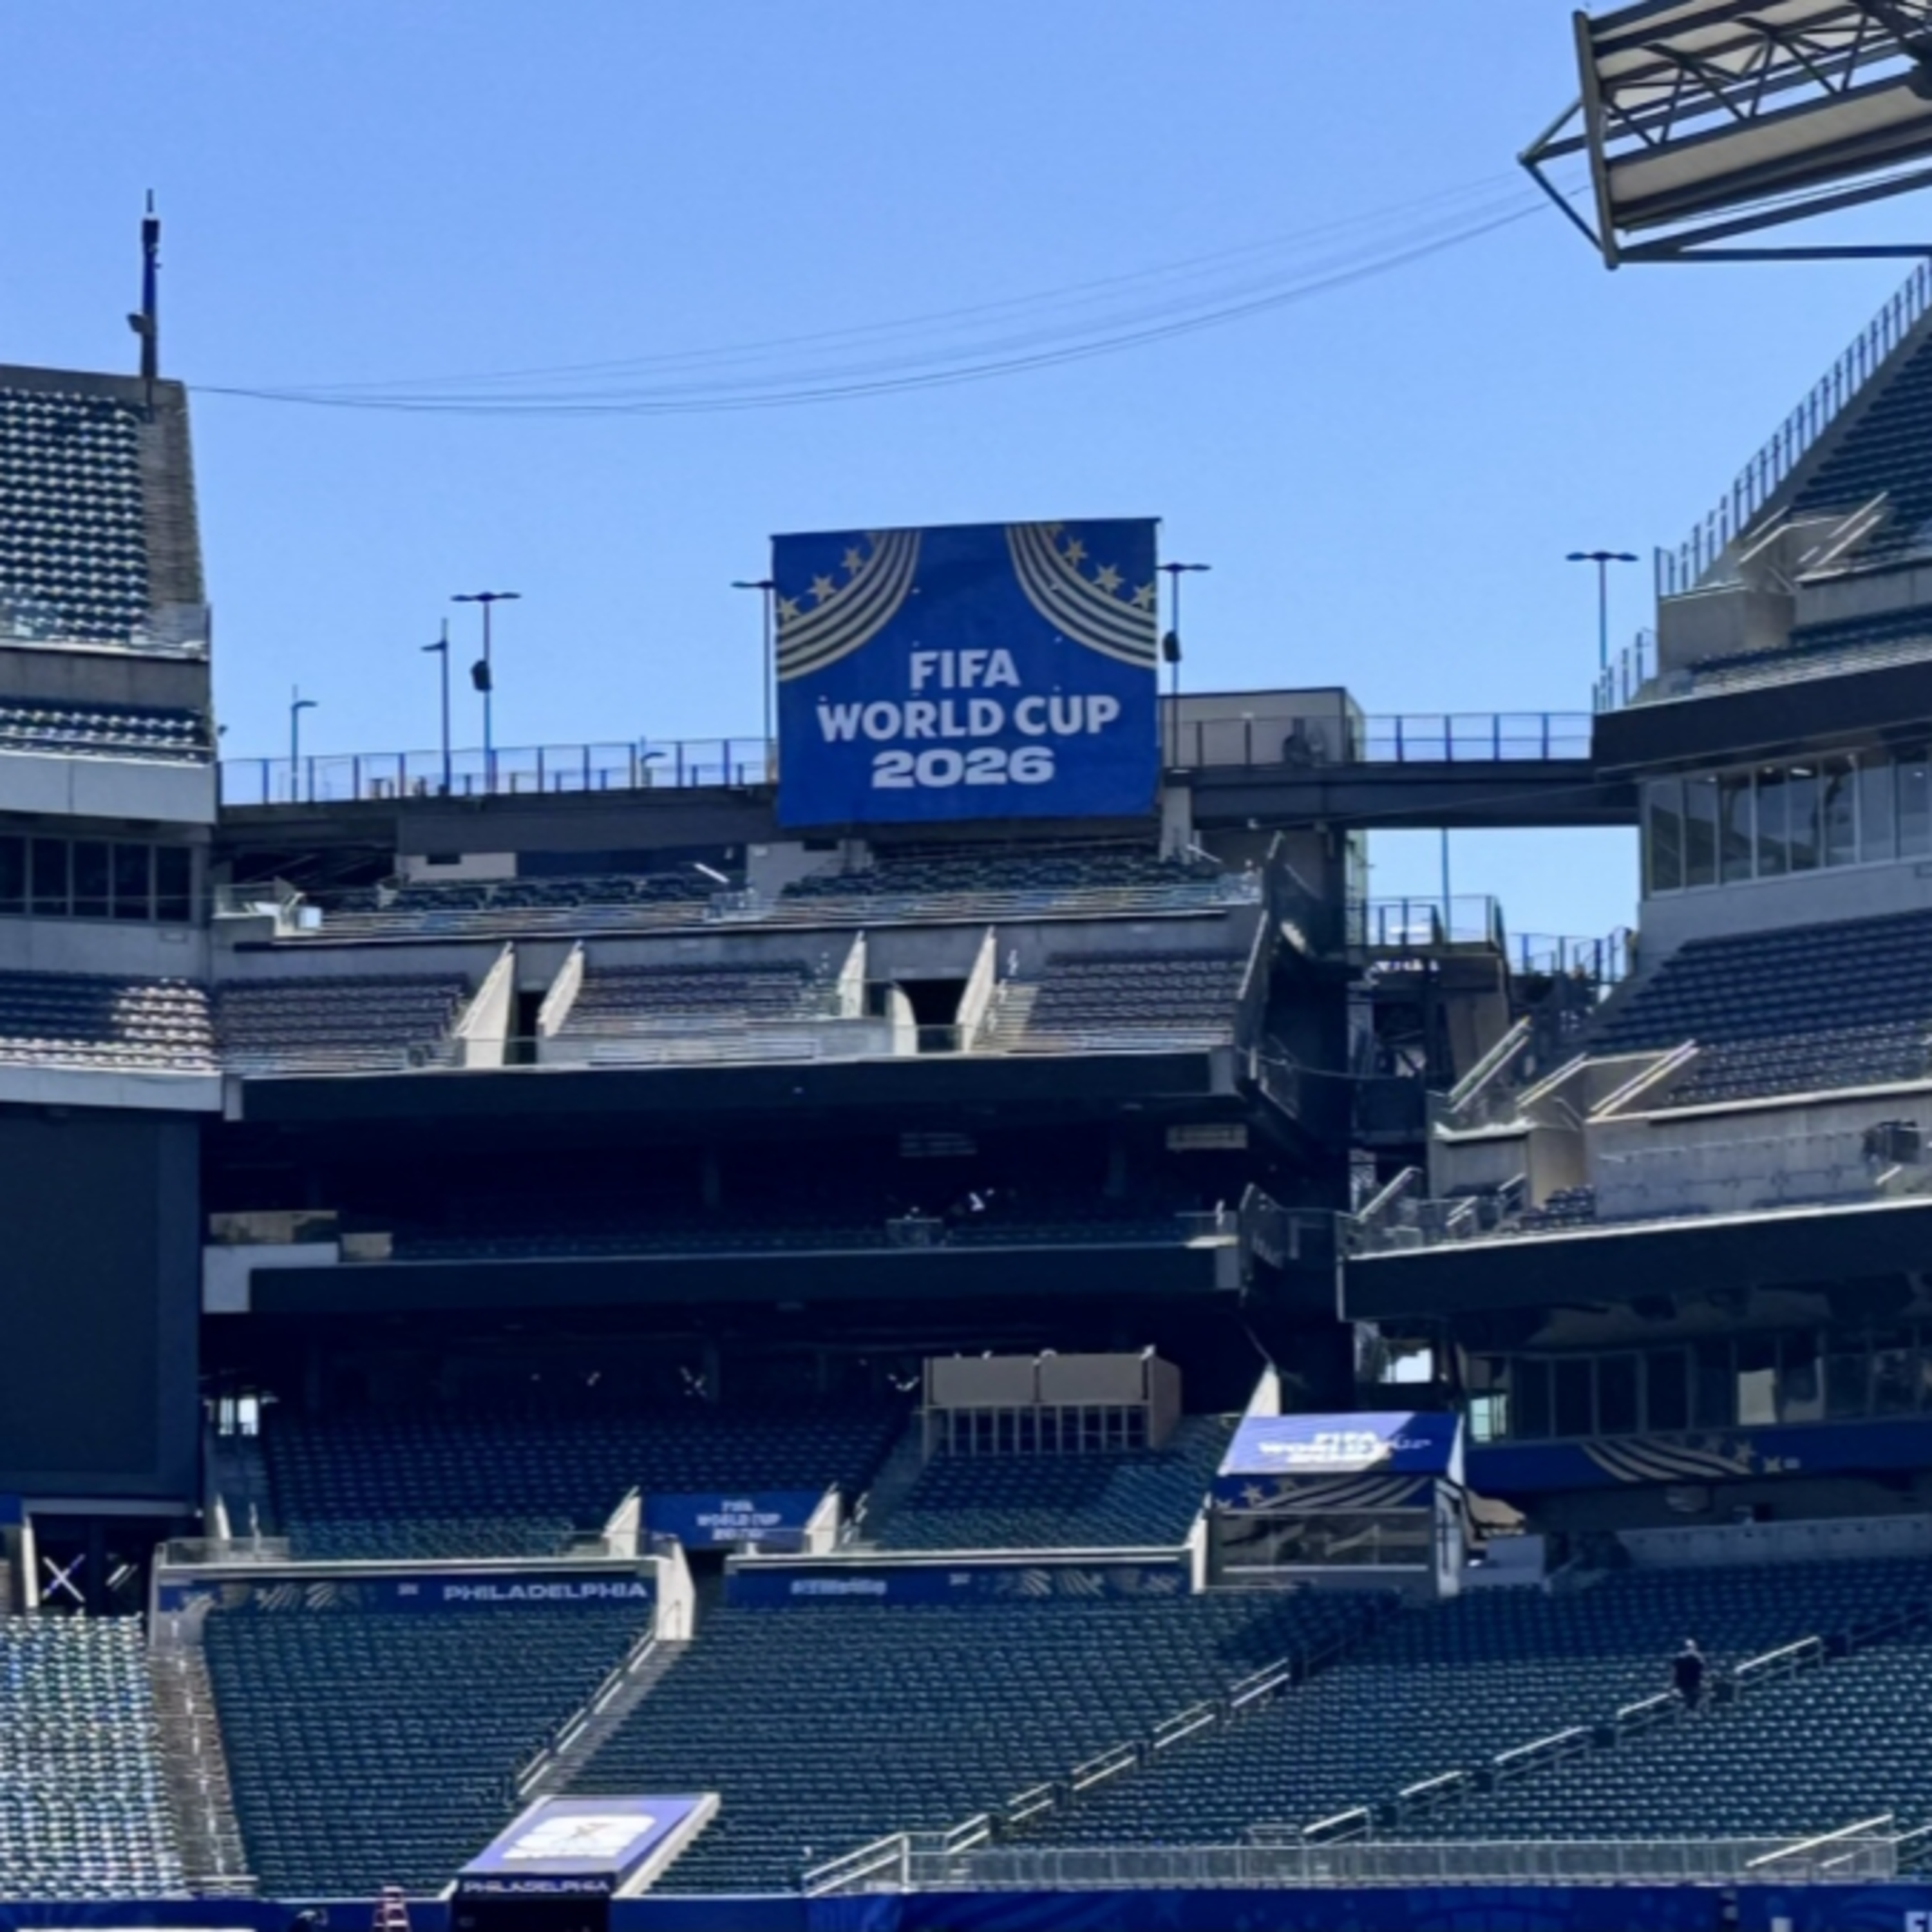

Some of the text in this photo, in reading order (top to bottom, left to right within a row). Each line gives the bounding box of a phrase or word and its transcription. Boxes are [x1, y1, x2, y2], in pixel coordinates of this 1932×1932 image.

[909, 649, 1021, 690] FIFA
[817, 695, 1120, 742] WORLD CUP
[871, 746, 1055, 788] 2026
[443, 1582, 648, 1600] PHILADELPHIA
